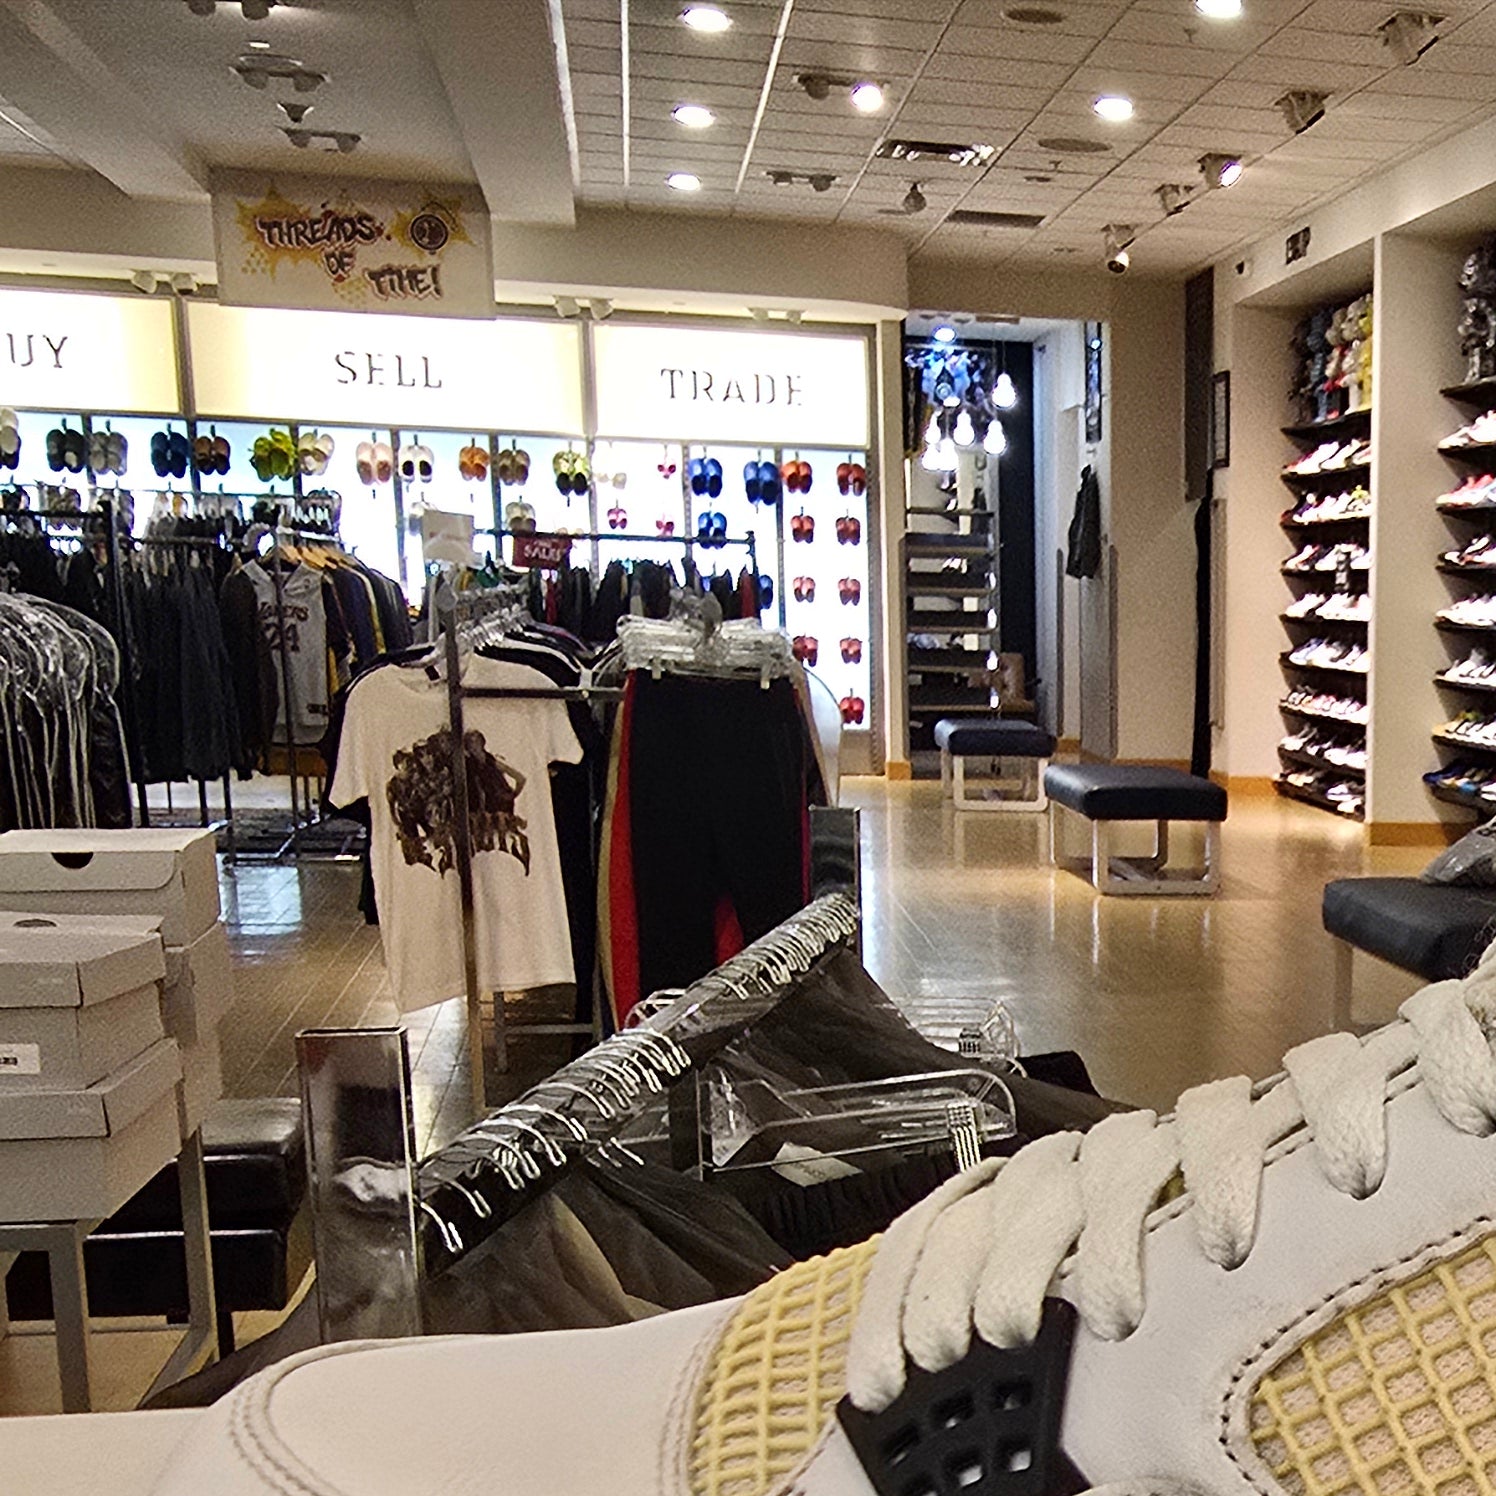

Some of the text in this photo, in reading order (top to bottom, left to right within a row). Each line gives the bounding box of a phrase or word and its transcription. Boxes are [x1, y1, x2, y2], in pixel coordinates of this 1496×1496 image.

[257, 212, 378, 246] THREADS
[323, 250, 353, 273] OF
[334, 350, 443, 389] SELL
[660, 367, 802, 406] TRADE
